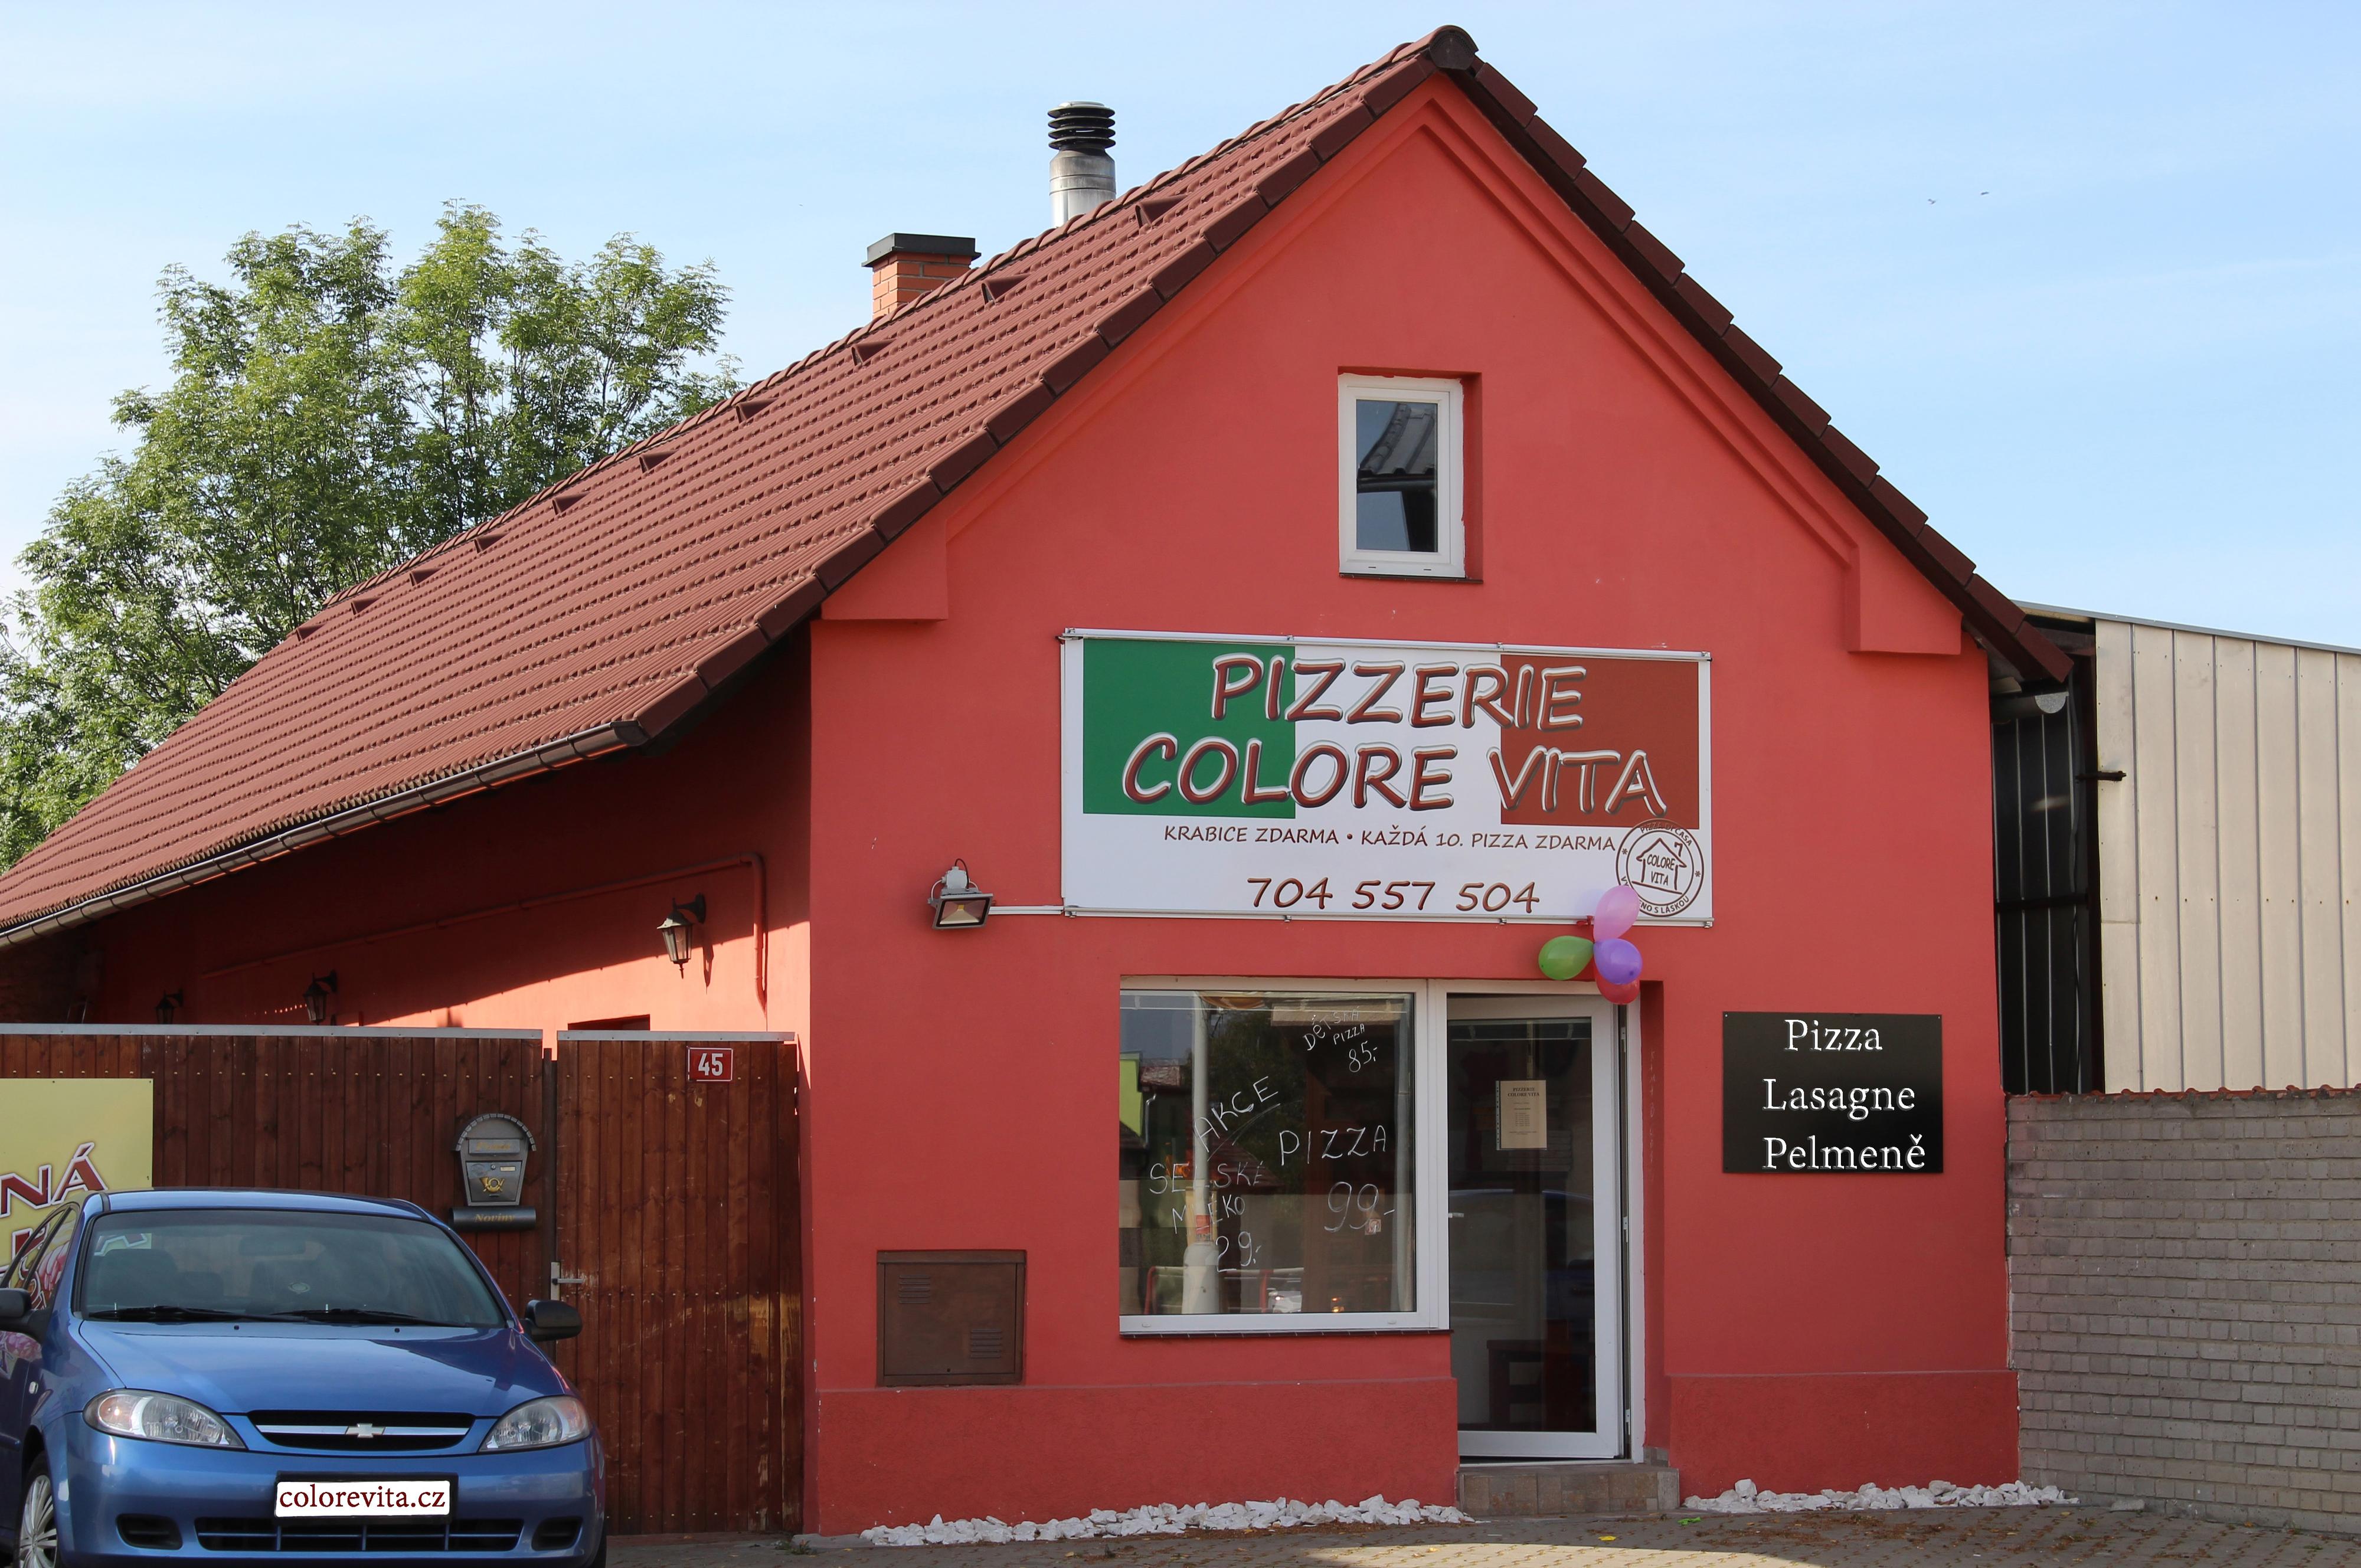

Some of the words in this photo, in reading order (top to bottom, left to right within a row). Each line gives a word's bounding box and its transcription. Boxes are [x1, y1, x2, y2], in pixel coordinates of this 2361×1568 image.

[1212, 653, 1587, 731] PIZZERIE
[1123, 732, 1458, 811] COLORE
[1486, 745, 1667, 817] VITA
[1164, 826, 1248, 842] KRABICE
[1255, 827, 1339, 844] ZDARMA
[1361, 824, 1428, 847] KAŽDÁ
[1435, 833, 1463, 847] 10.
[1471, 833, 1528, 849] PIZZA
[1535, 834, 1616, 851] ZDARMA
[1675, 827, 1693, 846] CASA
[1647, 854, 1675, 871] COLORE
[1651, 871, 1669, 886] VITA
[1247, 877, 1333, 909] 704
[1352, 880, 1435, 910] 557
[1456, 881, 1540, 914] 504
[1660, 896, 1690, 914] LÁSKOU
[1333, 1023, 1365, 1045] PIZZA
[1784, 1019, 1883, 1052] Pizza
[698, 1053, 723, 1076] 45
[1194, 1076, 1279, 1153] AKCE
[1762, 1078, 1915, 1121] Lasagne
[1279, 1125, 1386, 1166] PIZZA
[1762, 1134, 1926, 1170] Pelmeně
[279, 1484, 446, 1508] colorevita.cz
